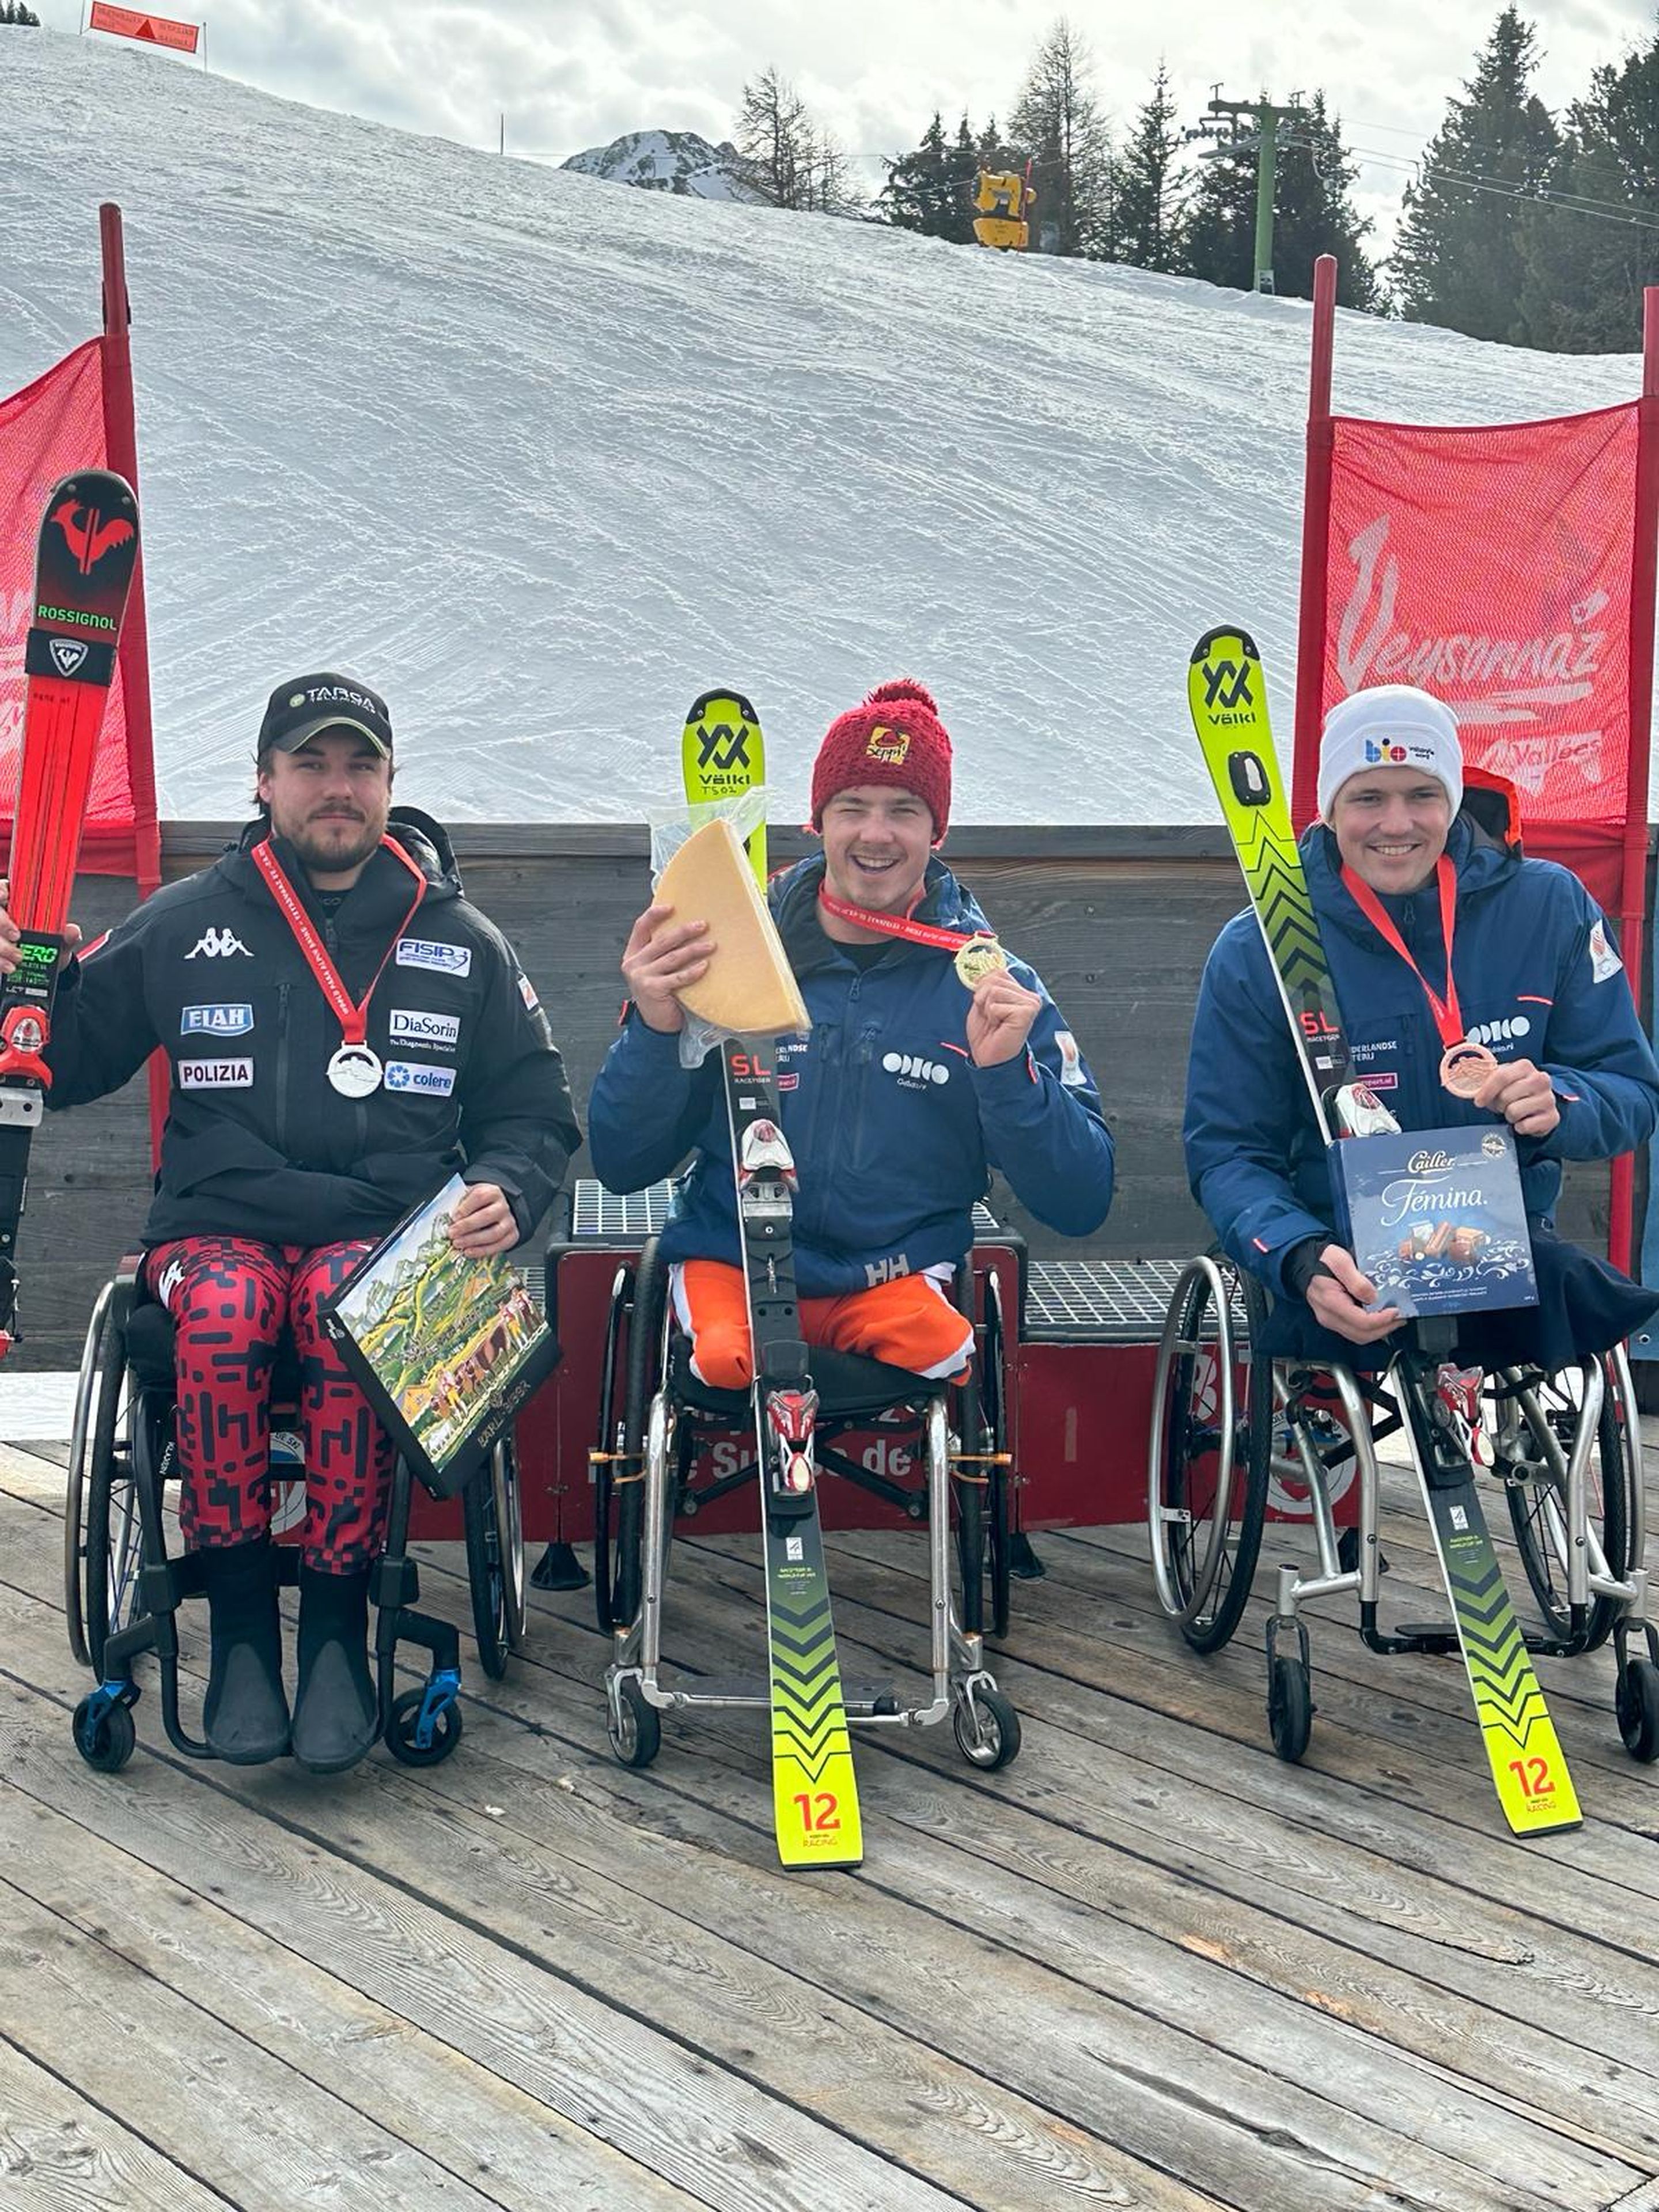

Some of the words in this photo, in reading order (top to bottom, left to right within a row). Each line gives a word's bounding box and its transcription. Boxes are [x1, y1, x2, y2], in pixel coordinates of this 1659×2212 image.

[37, 605, 118, 631] ROSSIGNOL
[1208, 711, 1256, 725] Völkl
[1365, 738, 1407, 763] bio
[699, 774, 750, 785] Völkl
[20, 944, 58, 964] ERO
[400, 941, 454, 957] FISIP
[394, 1014, 457, 1038] DiaSorin
[1301, 1010, 1339, 1035] SL
[184, 1065, 249, 1082] POLIZIA
[730, 1054, 771, 1076] SL
[413, 1072, 452, 1089] colere
[865, 1253, 910, 1288] HH
[863, 1439, 911, 1476] de
[1509, 1758, 1556, 1797] 12
[794, 1793, 841, 1832] 12
